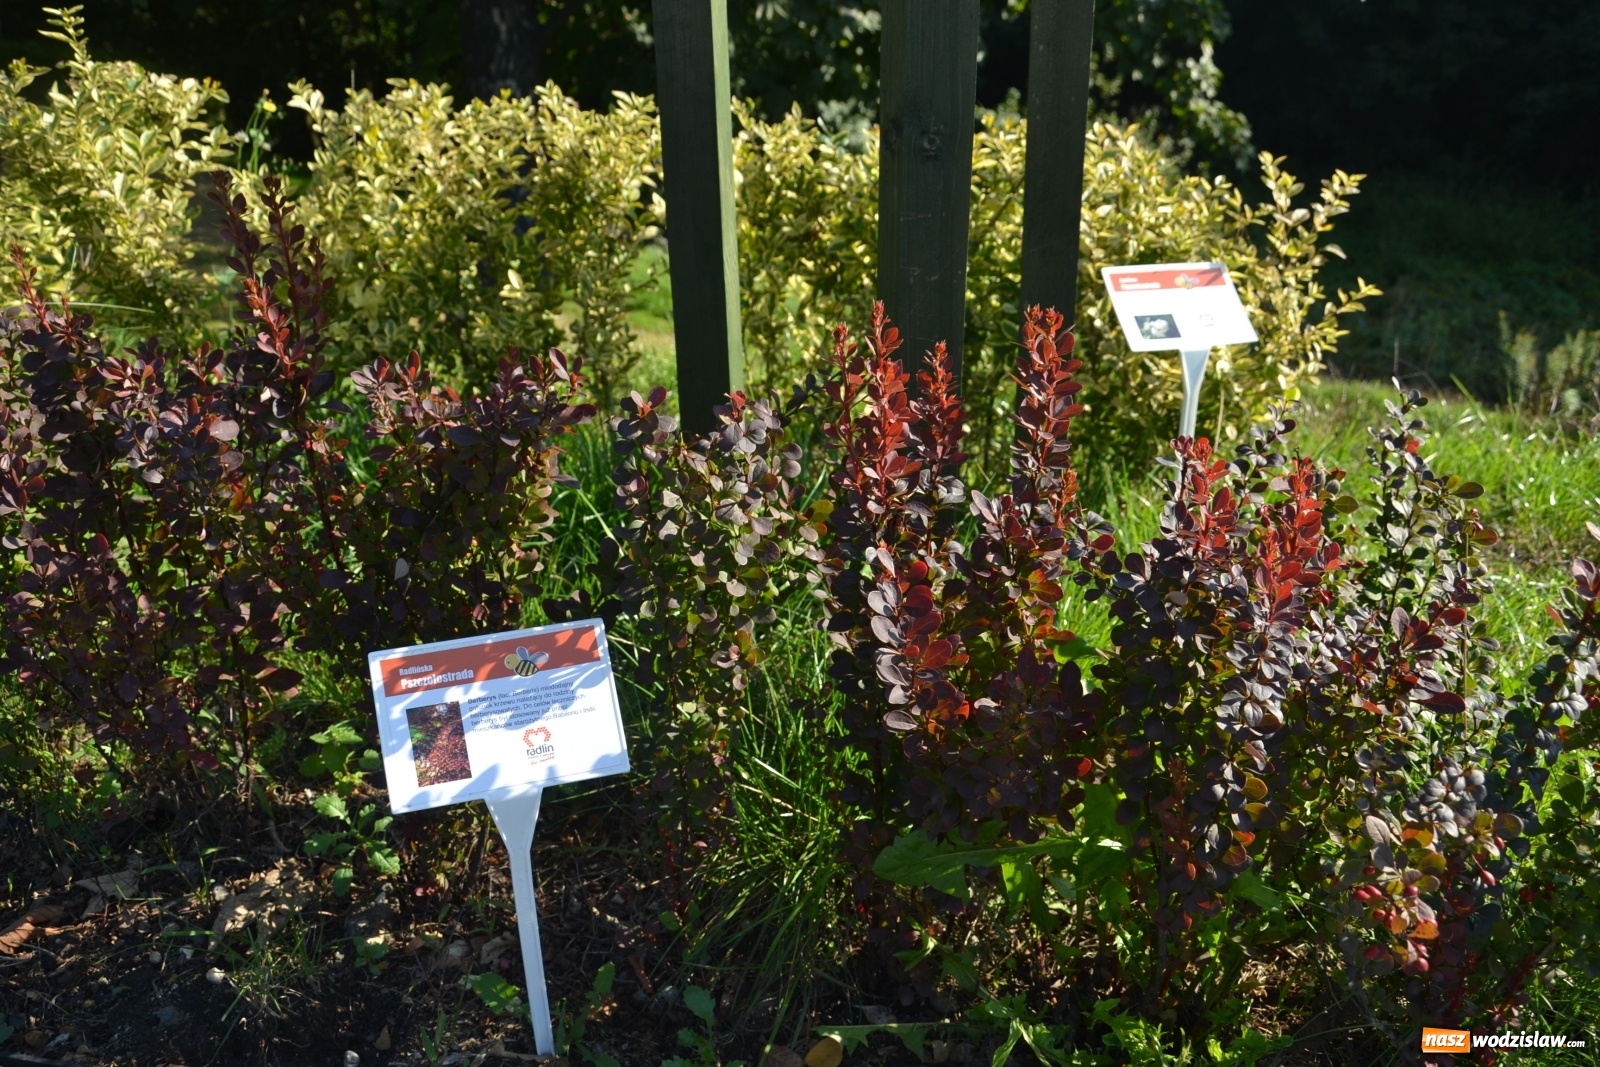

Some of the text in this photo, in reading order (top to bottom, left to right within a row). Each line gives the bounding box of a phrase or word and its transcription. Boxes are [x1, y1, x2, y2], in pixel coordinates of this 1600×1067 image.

[399, 665, 433, 676] Radlińska
[468, 695, 496, 704] Berberys
[540, 681, 573, 691] miododajny
[516, 695, 543, 703] należący
[552, 693, 585, 704] leczniczych
[472, 717, 497, 726] berberys
[509, 709, 539, 719] stosowany
[552, 705, 568, 713] przez
[553, 709, 578, 719] Babilonu
[526, 743, 555, 756] radlin
